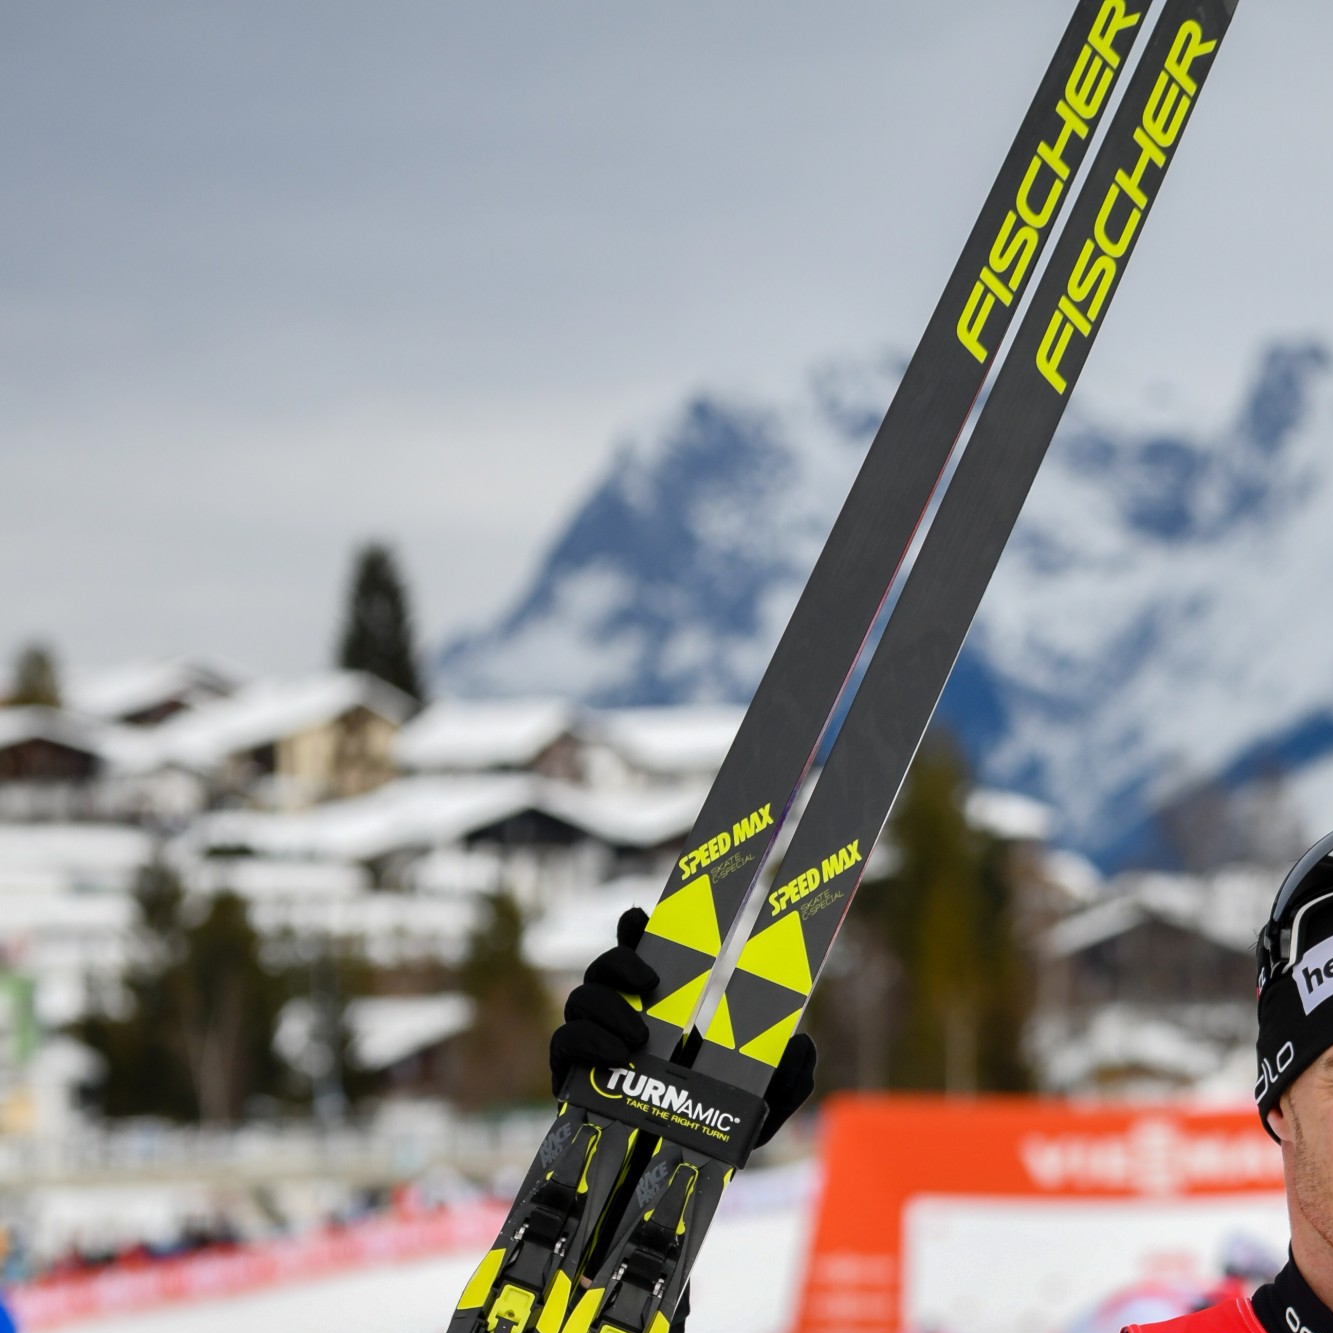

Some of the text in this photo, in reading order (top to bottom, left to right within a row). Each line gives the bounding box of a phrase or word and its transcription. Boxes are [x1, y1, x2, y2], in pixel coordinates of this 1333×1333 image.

[957, 0, 1141, 364] FISCHER
[1036, 20, 1217, 395] FISCHER
[679, 803, 774, 880] SPEED MAX
[711, 852, 742, 875] SKATE
[768, 839, 862, 916] SPEED MAX
[800, 889, 830, 911] SKATE
[626, 1097, 730, 1143] TAKE THE RIGHT TURN!
